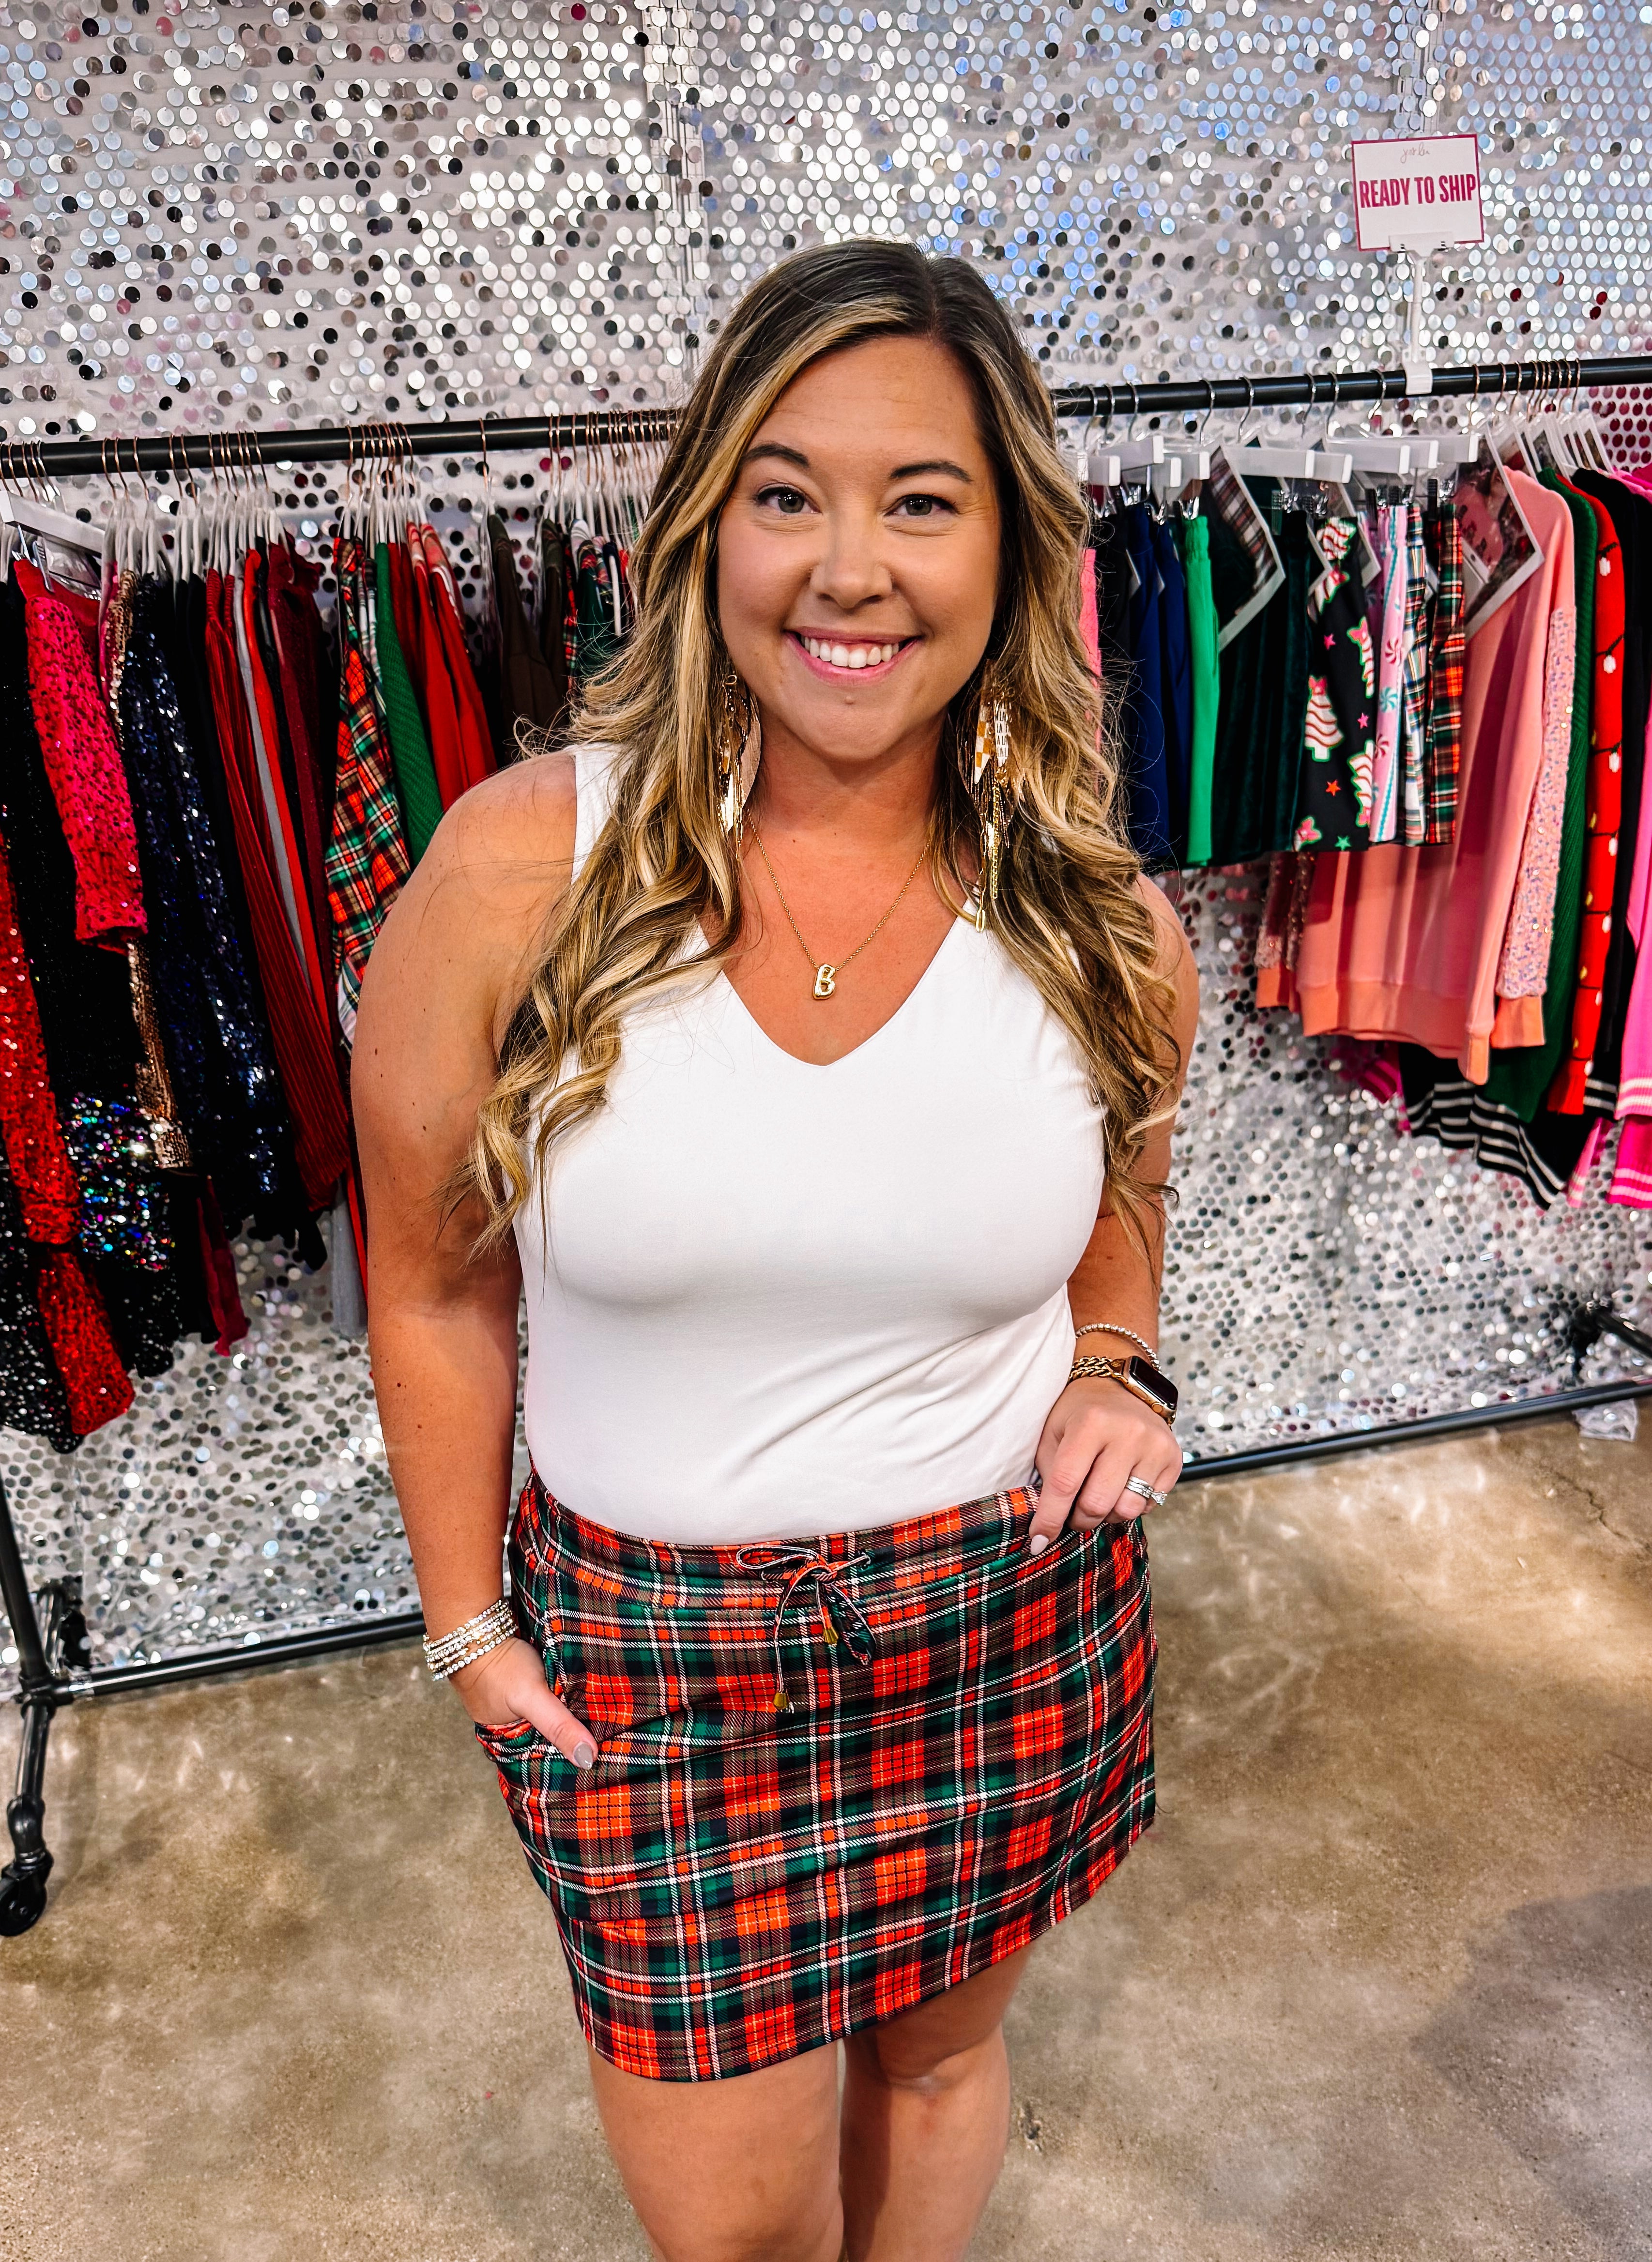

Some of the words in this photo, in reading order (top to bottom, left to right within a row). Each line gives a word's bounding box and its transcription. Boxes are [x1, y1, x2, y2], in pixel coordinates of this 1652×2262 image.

[1359, 178, 1410, 208] READY
[1414, 176, 1435, 204] TO
[1438, 174, 1476, 202] SHIP
[814, 964, 836, 997] B
